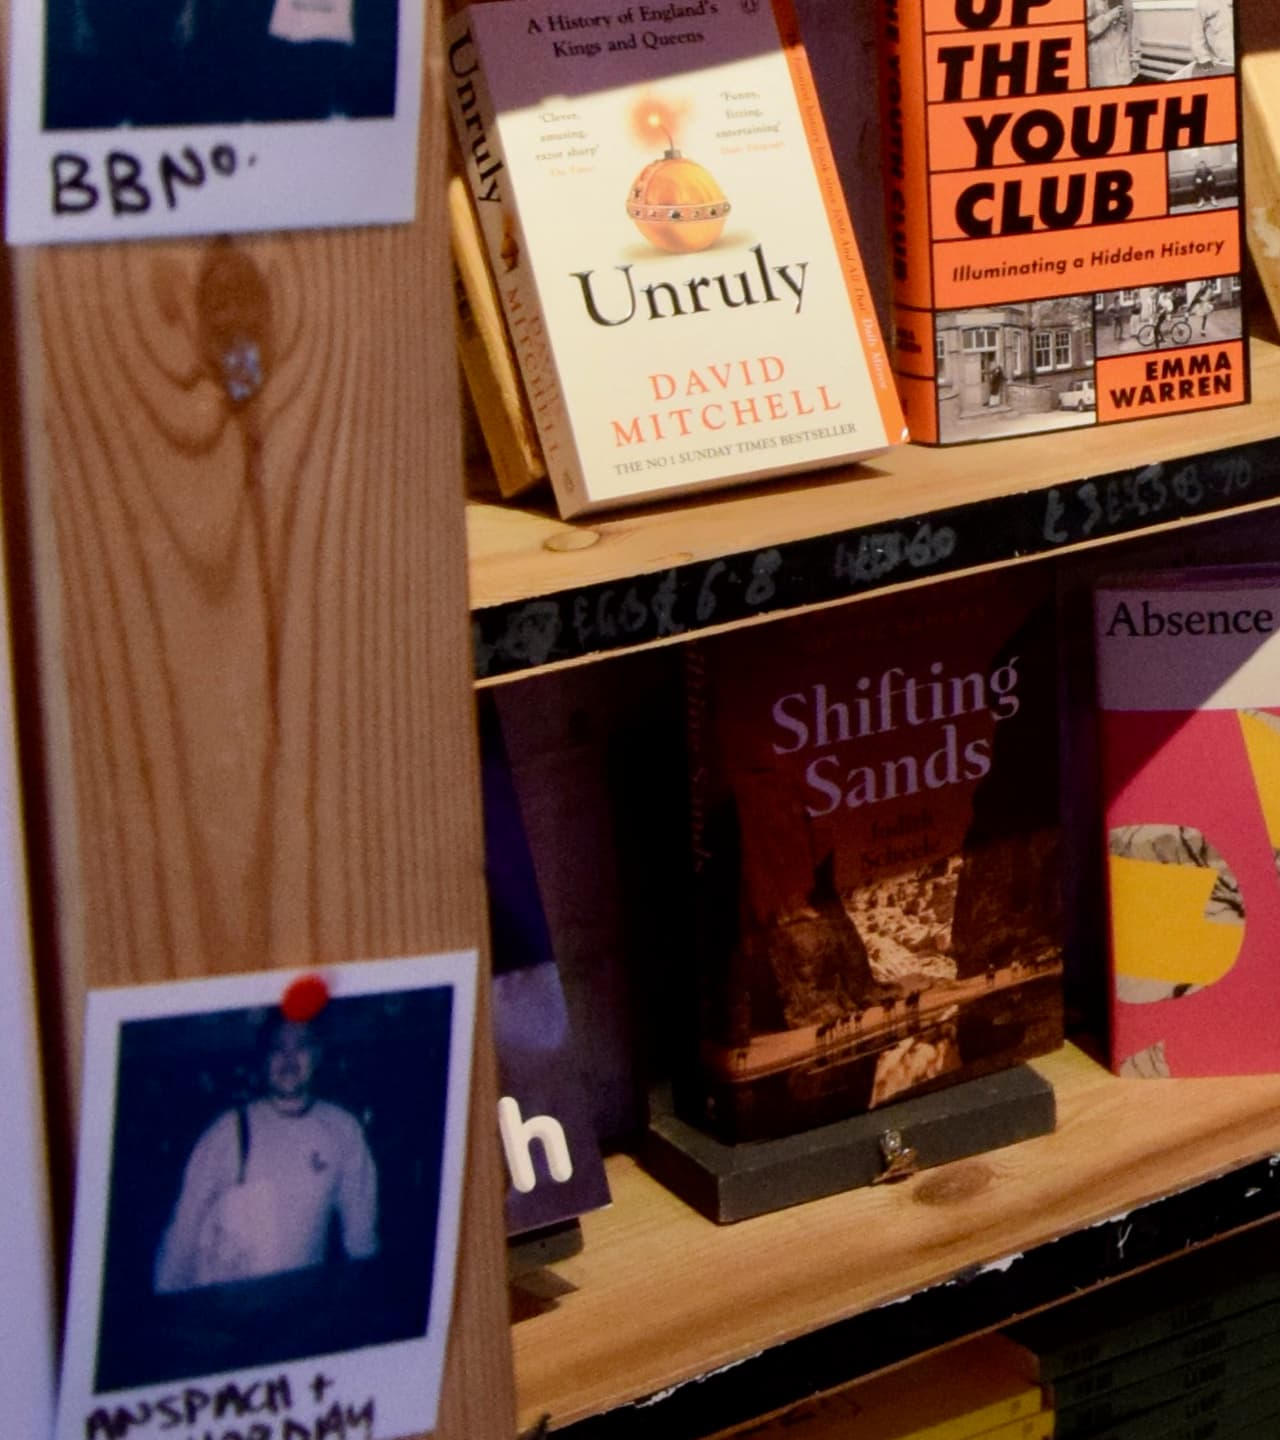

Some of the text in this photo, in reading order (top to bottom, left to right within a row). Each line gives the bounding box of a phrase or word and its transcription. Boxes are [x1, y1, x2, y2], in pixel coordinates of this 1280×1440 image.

[527, 19, 543, 35] A
[547, 10, 610, 34] History
[616, 7, 634, 24] of
[552, 29, 705, 60] Kings and Queens
[937, 37, 1072, 103] THE
[963, 93, 1208, 169] YOUTH
[955, 168, 1134, 238] CLUB
[570, 244, 810, 328] Unruly
[951, 237, 1225, 283] Illuminating a Hidden History
[648, 353, 786, 401] DAVID
[1109, 374, 1232, 408] WARREN
[1146, 351, 1232, 381] EMMA
[610, 383, 843, 448] MITCHELL
[1104, 600, 1275, 641] Absence
[770, 656, 1023, 758] Shifting
[803, 731, 993, 820] Sands
